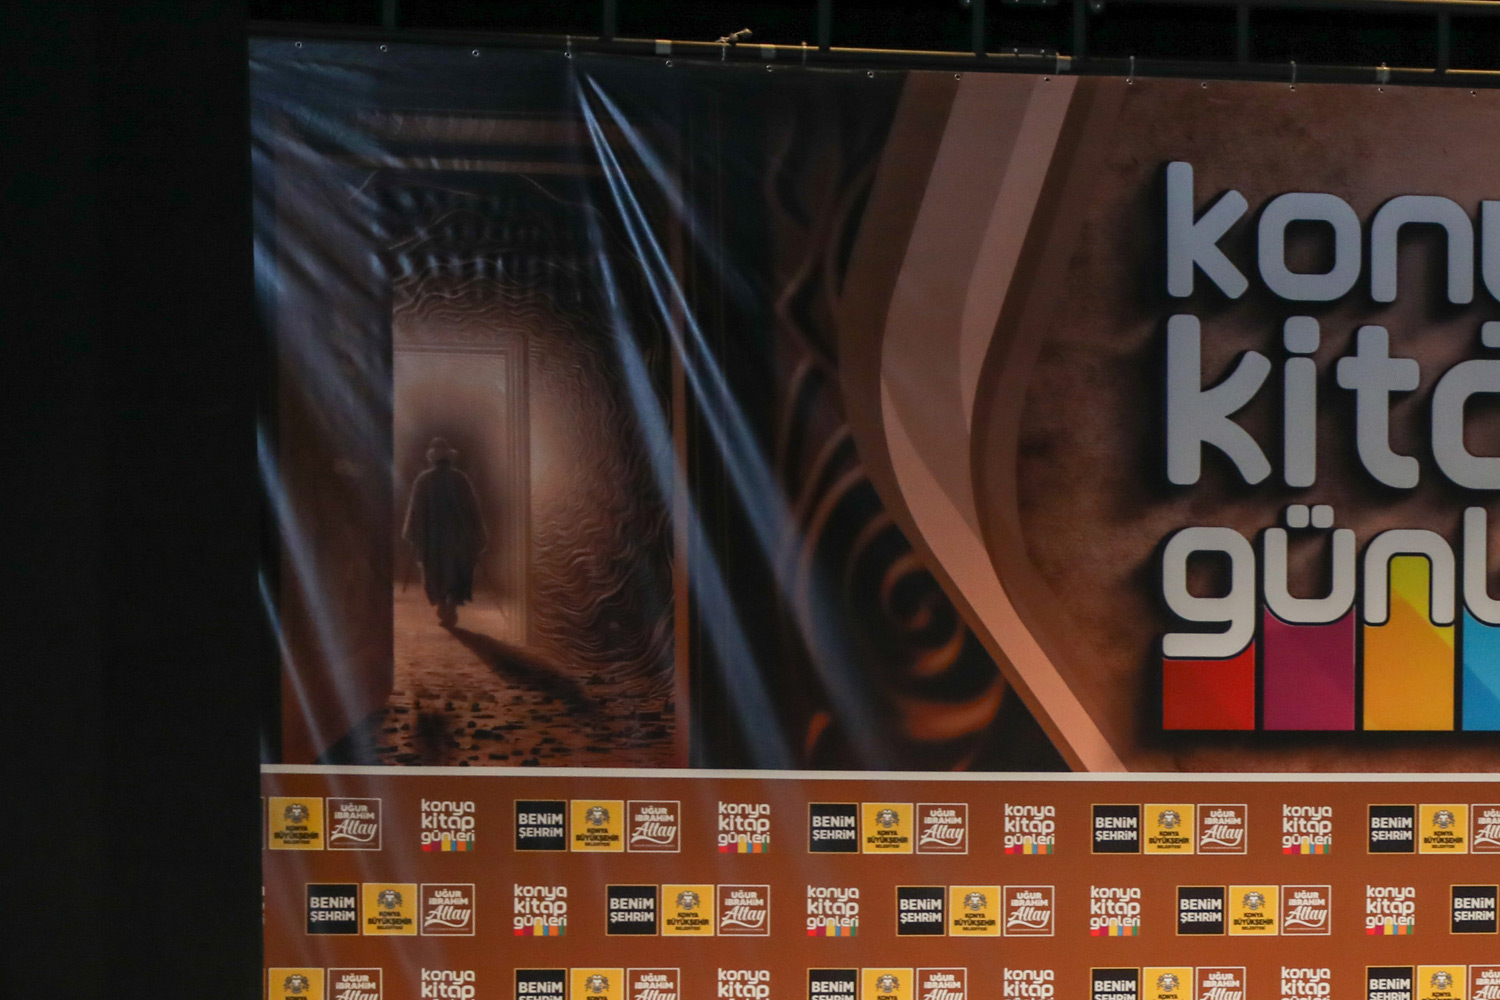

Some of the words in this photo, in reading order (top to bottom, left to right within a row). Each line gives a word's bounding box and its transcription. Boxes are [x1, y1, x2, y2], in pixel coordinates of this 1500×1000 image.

[420, 798, 476, 816] konya
[639, 806, 667, 815] UĞUR
[718, 800, 770, 818] konya
[1282, 804, 1332, 820] konya
[420, 813, 476, 832] kitap
[718, 815, 770, 834] kitap
[1282, 817, 1332, 836] kitap
[420, 829, 476, 845] günleri
[629, 821, 676, 844] Altay
[718, 831, 770, 847] günleri
[1282, 833, 1332, 848] günleri
[514, 883, 568, 901] konya
[806, 884, 860, 902] konya
[1016, 891, 1042, 900] UĞUR
[1090, 886, 1140, 902] konya
[514, 898, 568, 917] kitap
[806, 899, 860, 917] kitap
[1006, 906, 1050, 927] Altay
[1090, 899, 1140, 918] kitap
[514, 914, 568, 930] günleri
[806, 915, 860, 930] günleri
[1090, 915, 1140, 930] günleri
[928, 974, 954, 983] UĞUR
[1002, 968, 1054, 984] konya
[1280, 966, 1330, 982] konya
[1002, 981, 1054, 1000] kitap
[1280, 979, 1330, 998] kitap
